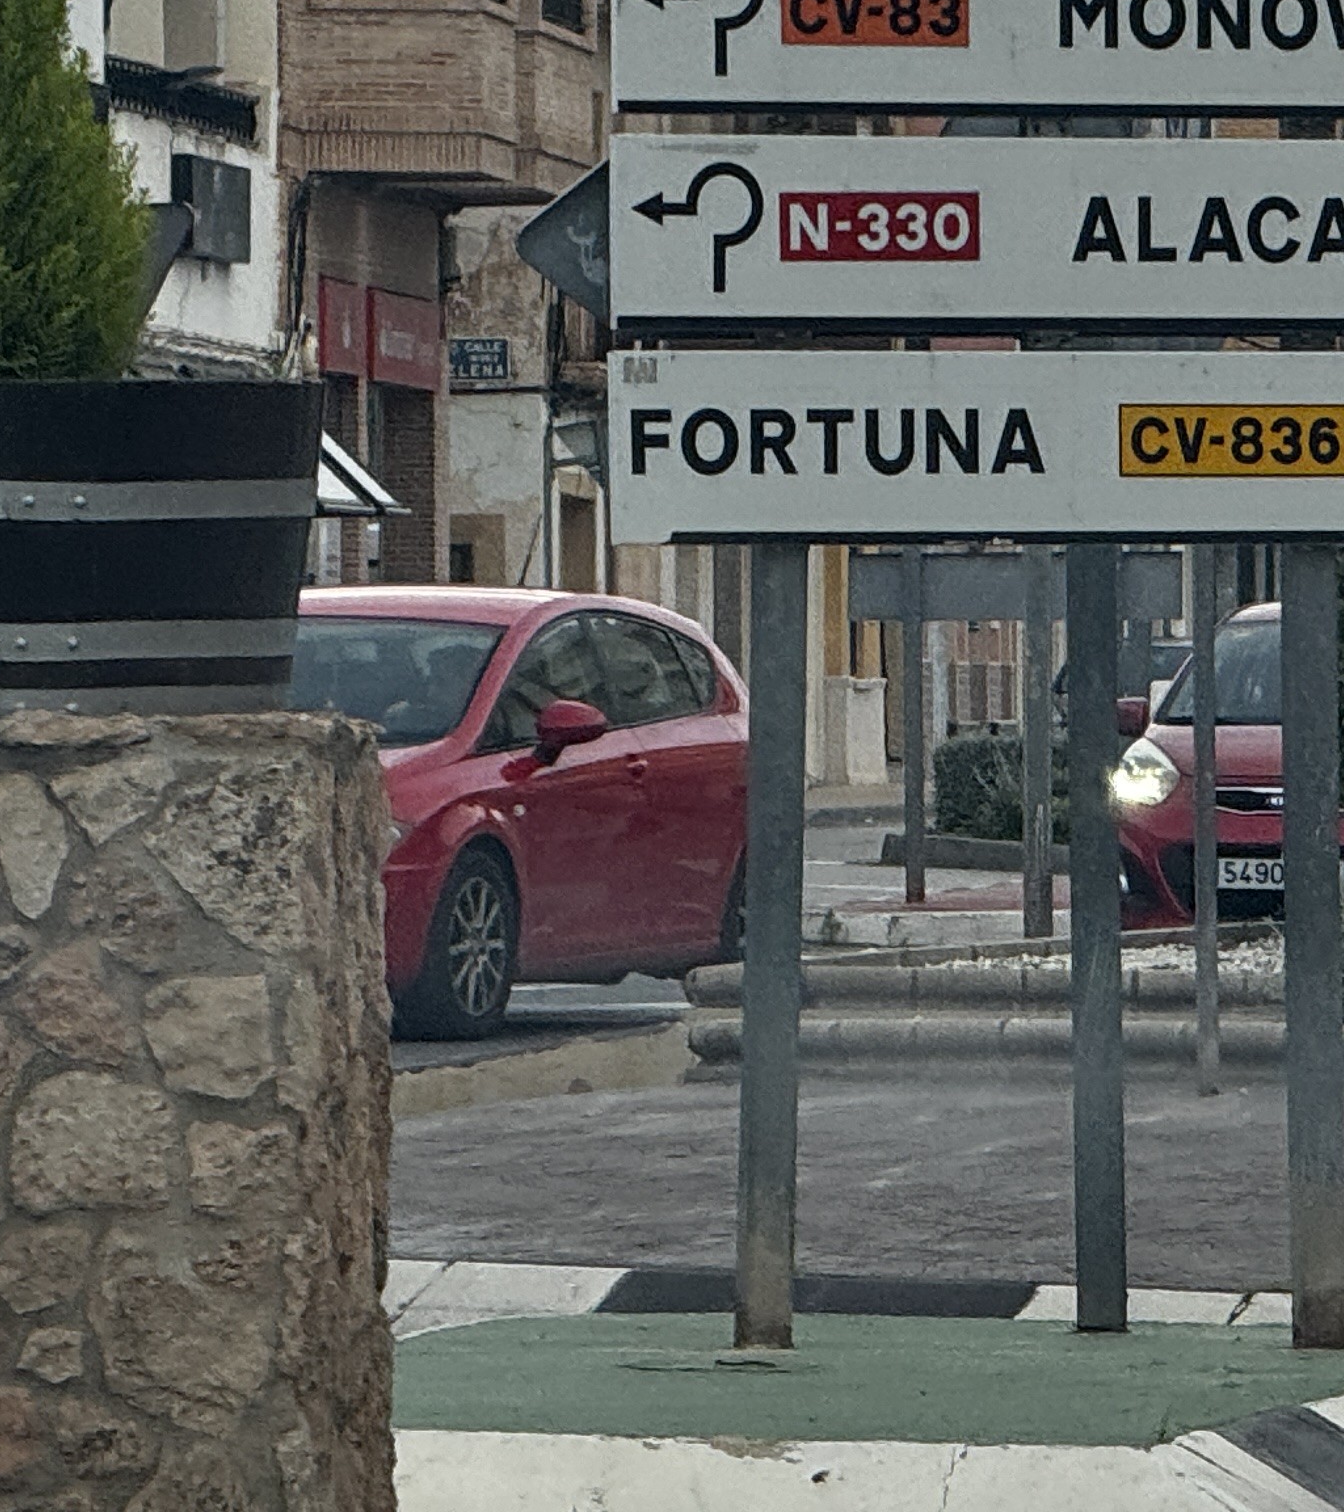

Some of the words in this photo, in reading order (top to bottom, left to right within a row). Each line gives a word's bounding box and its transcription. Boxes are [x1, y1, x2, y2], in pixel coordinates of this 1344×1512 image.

[790, 203, 969, 251] N-330
[631, 408, 1045, 476] FORTUNA
[1131, 417, 1340, 464] CV-836
[1223, 861, 1285, 885] 5490
